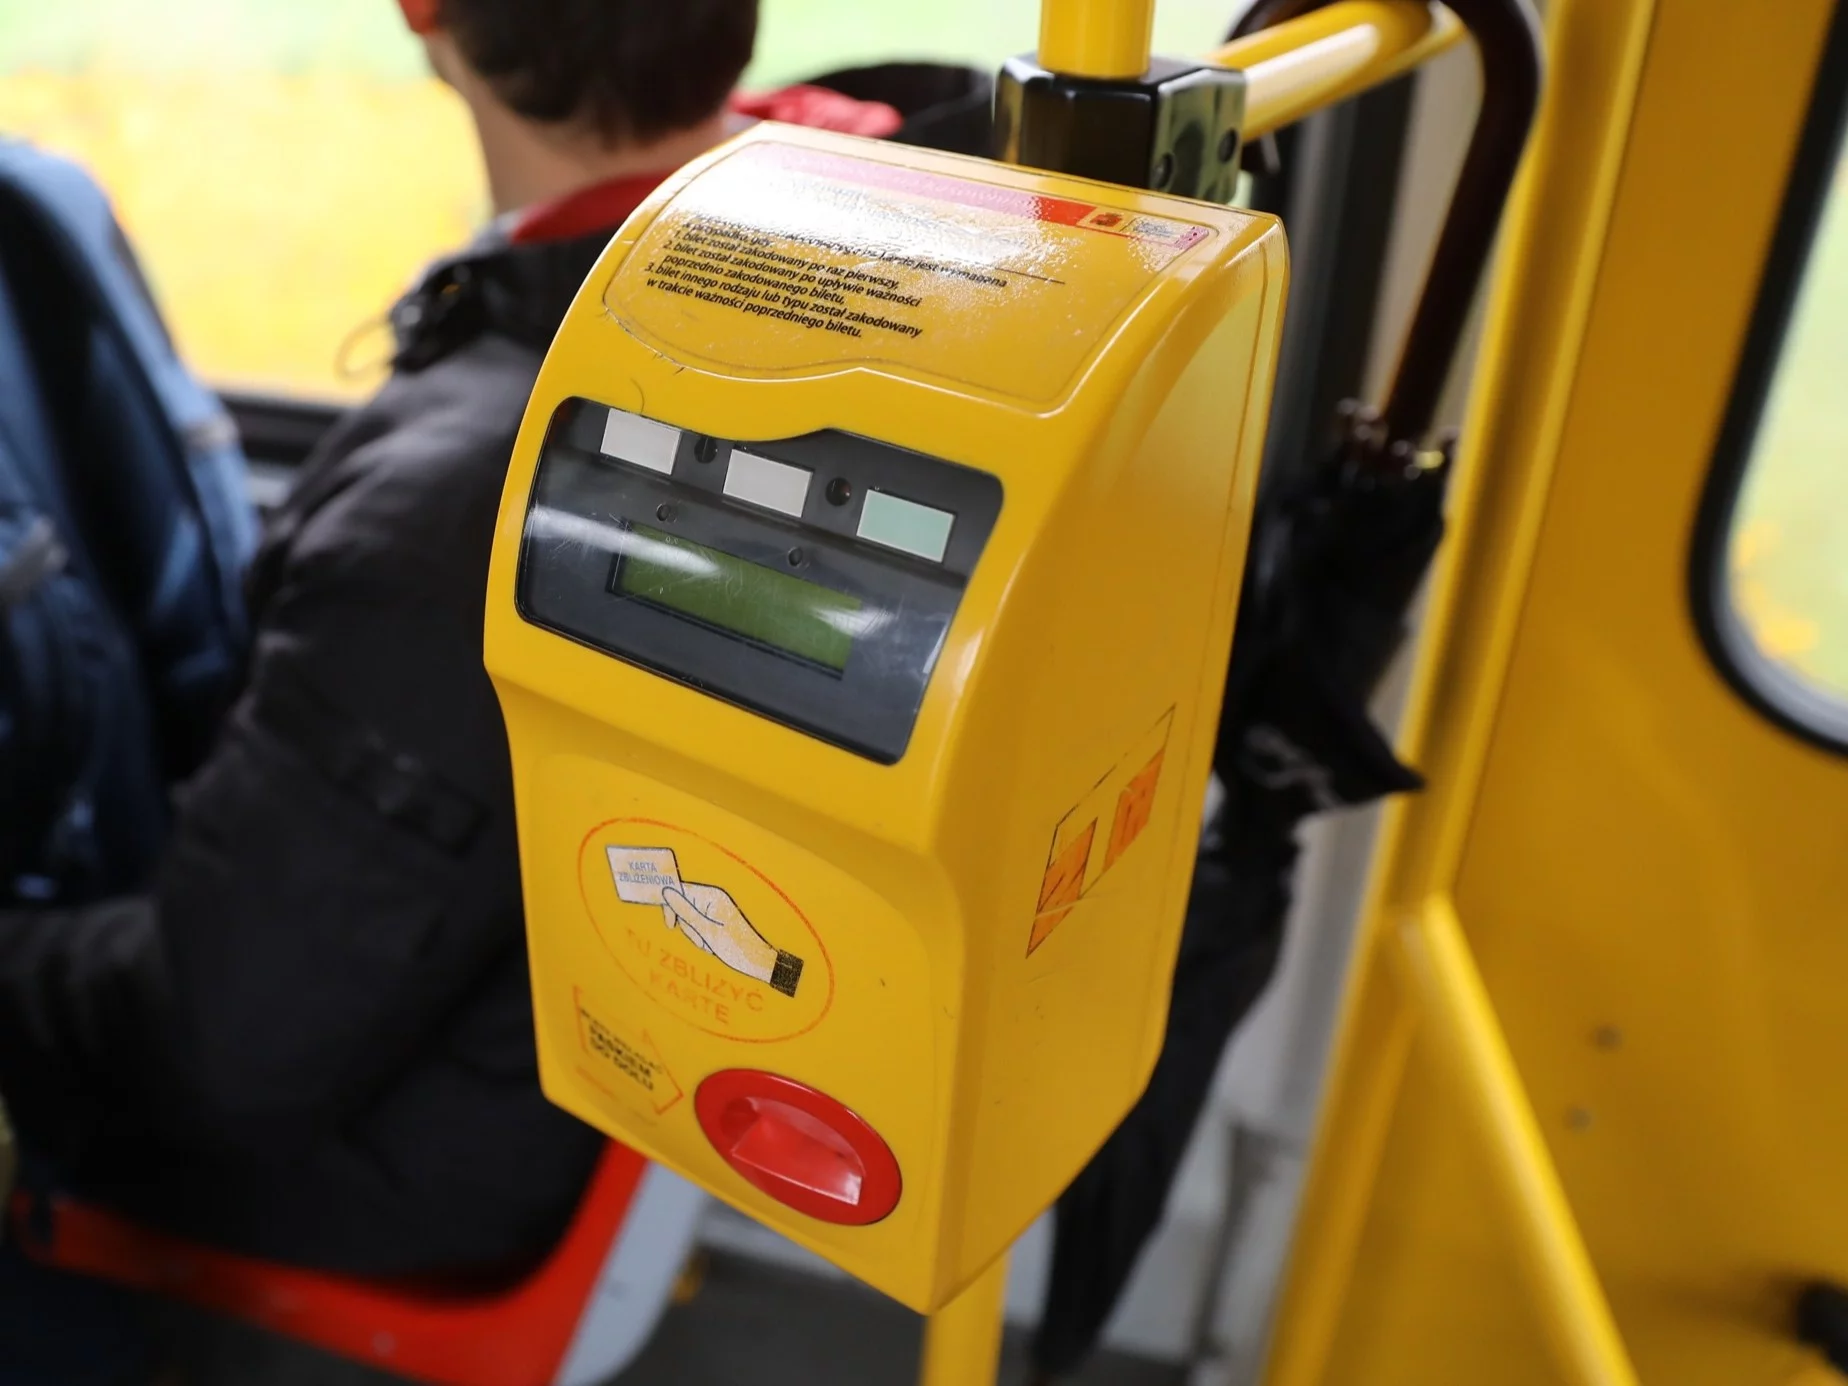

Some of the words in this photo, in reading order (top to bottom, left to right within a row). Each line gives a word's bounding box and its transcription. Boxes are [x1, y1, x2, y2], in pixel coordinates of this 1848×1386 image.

[662, 254, 724, 276] poprzednio
[723, 269, 809, 296] zakodowanego
[809, 286, 845, 306] biletu,
[663, 240, 672, 251] 2.
[673, 241, 698, 257] bilet
[698, 249, 732, 264] został
[730, 256, 800, 280] zakodowany
[799, 271, 817, 284] po
[816, 275, 864, 295] upływie
[865, 287, 923, 308] ważności
[683, 231, 706, 244] bilet
[707, 237, 741, 252] został
[739, 244, 808, 269] zakodowany
[807, 261, 825, 273] po
[826, 265, 845, 277] raz
[844, 268, 899, 290] pierwszy,
[644, 262, 654, 273] 3.
[655, 262, 681, 279] bilet
[680, 270, 718, 288] innego
[718, 280, 761, 299] rodzaju
[760, 289, 781, 303] lub
[781, 295, 810, 310] typu
[809, 301, 847, 318] został
[845, 311, 923, 339] zakodowany
[647, 278, 657, 288] w
[657, 279, 694, 297] trakcie
[694, 289, 745, 310] ważności
[743, 301, 825, 330] poprzedniego
[824, 318, 863, 338] biletu.
[628, 861, 657, 873] KARTA
